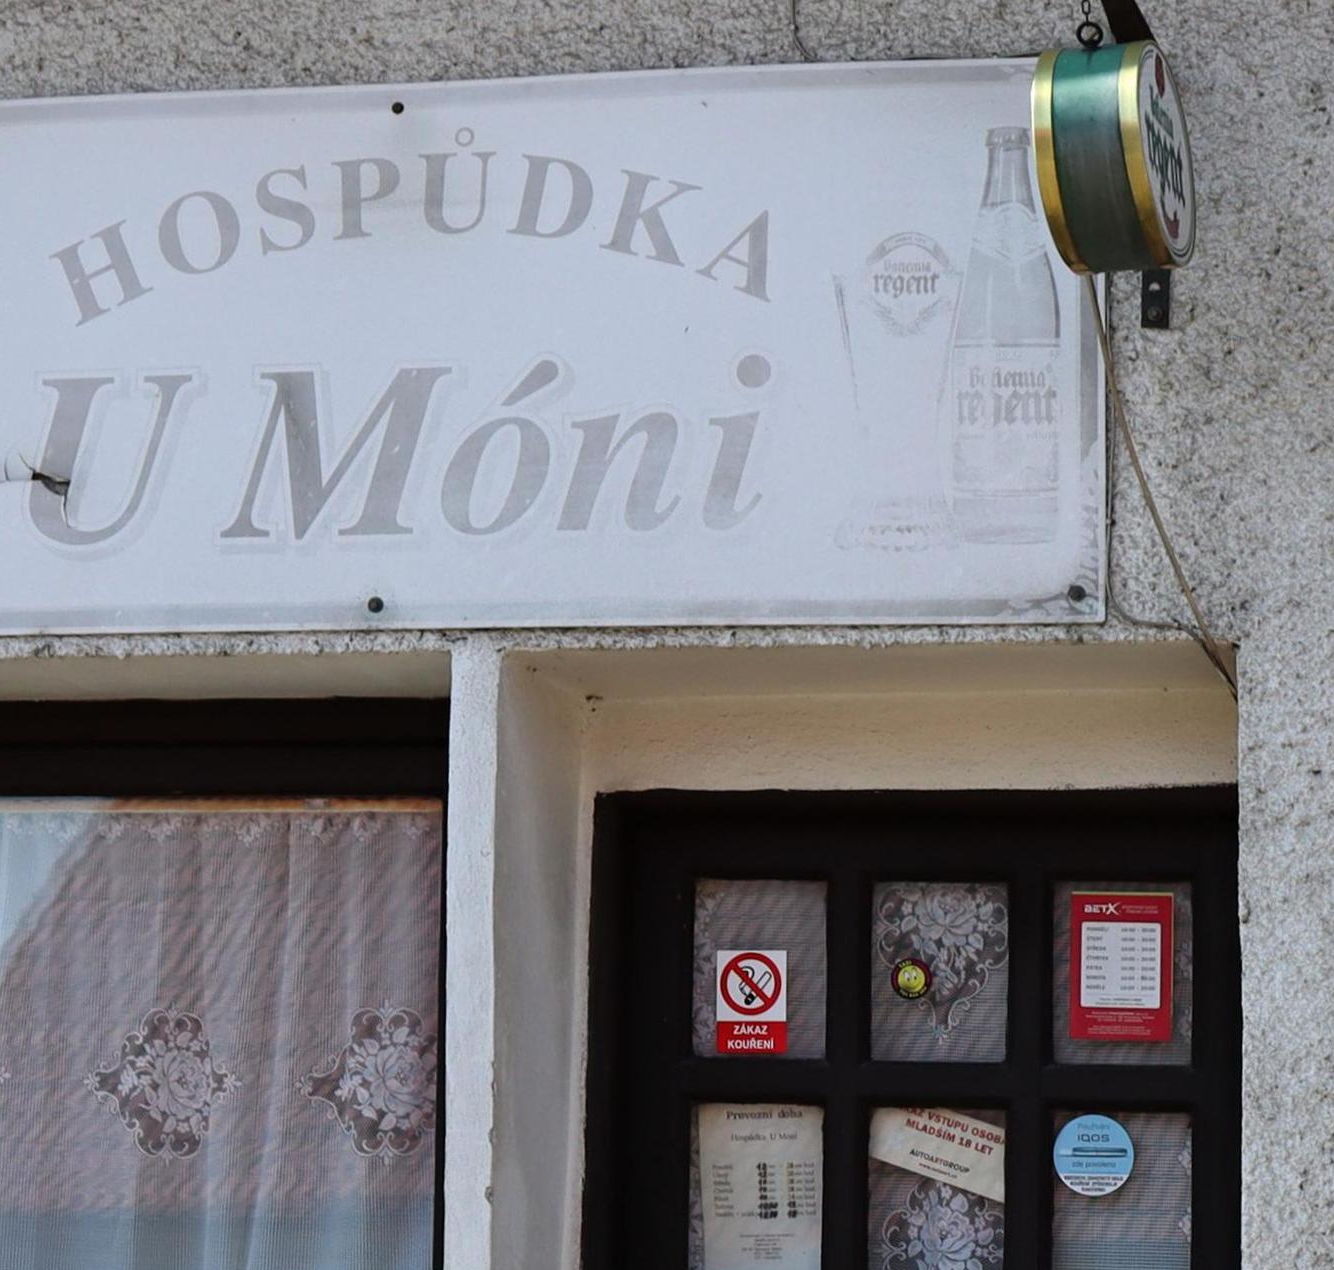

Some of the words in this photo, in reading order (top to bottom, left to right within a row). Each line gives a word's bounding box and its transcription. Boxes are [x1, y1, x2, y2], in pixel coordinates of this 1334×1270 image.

[49, 127, 771, 326] HOSPŮDKA
[28, 374, 193, 545] U
[220, 354, 773, 541] Móni
[733, 1023, 768, 1035] ZÁKAZ
[727, 1037, 774, 1050] KOUŘENÍ
[958, 1136, 972, 1149] 18
[974, 1142, 994, 1156] LET
[1077, 1134, 1110, 1144] IQOS
